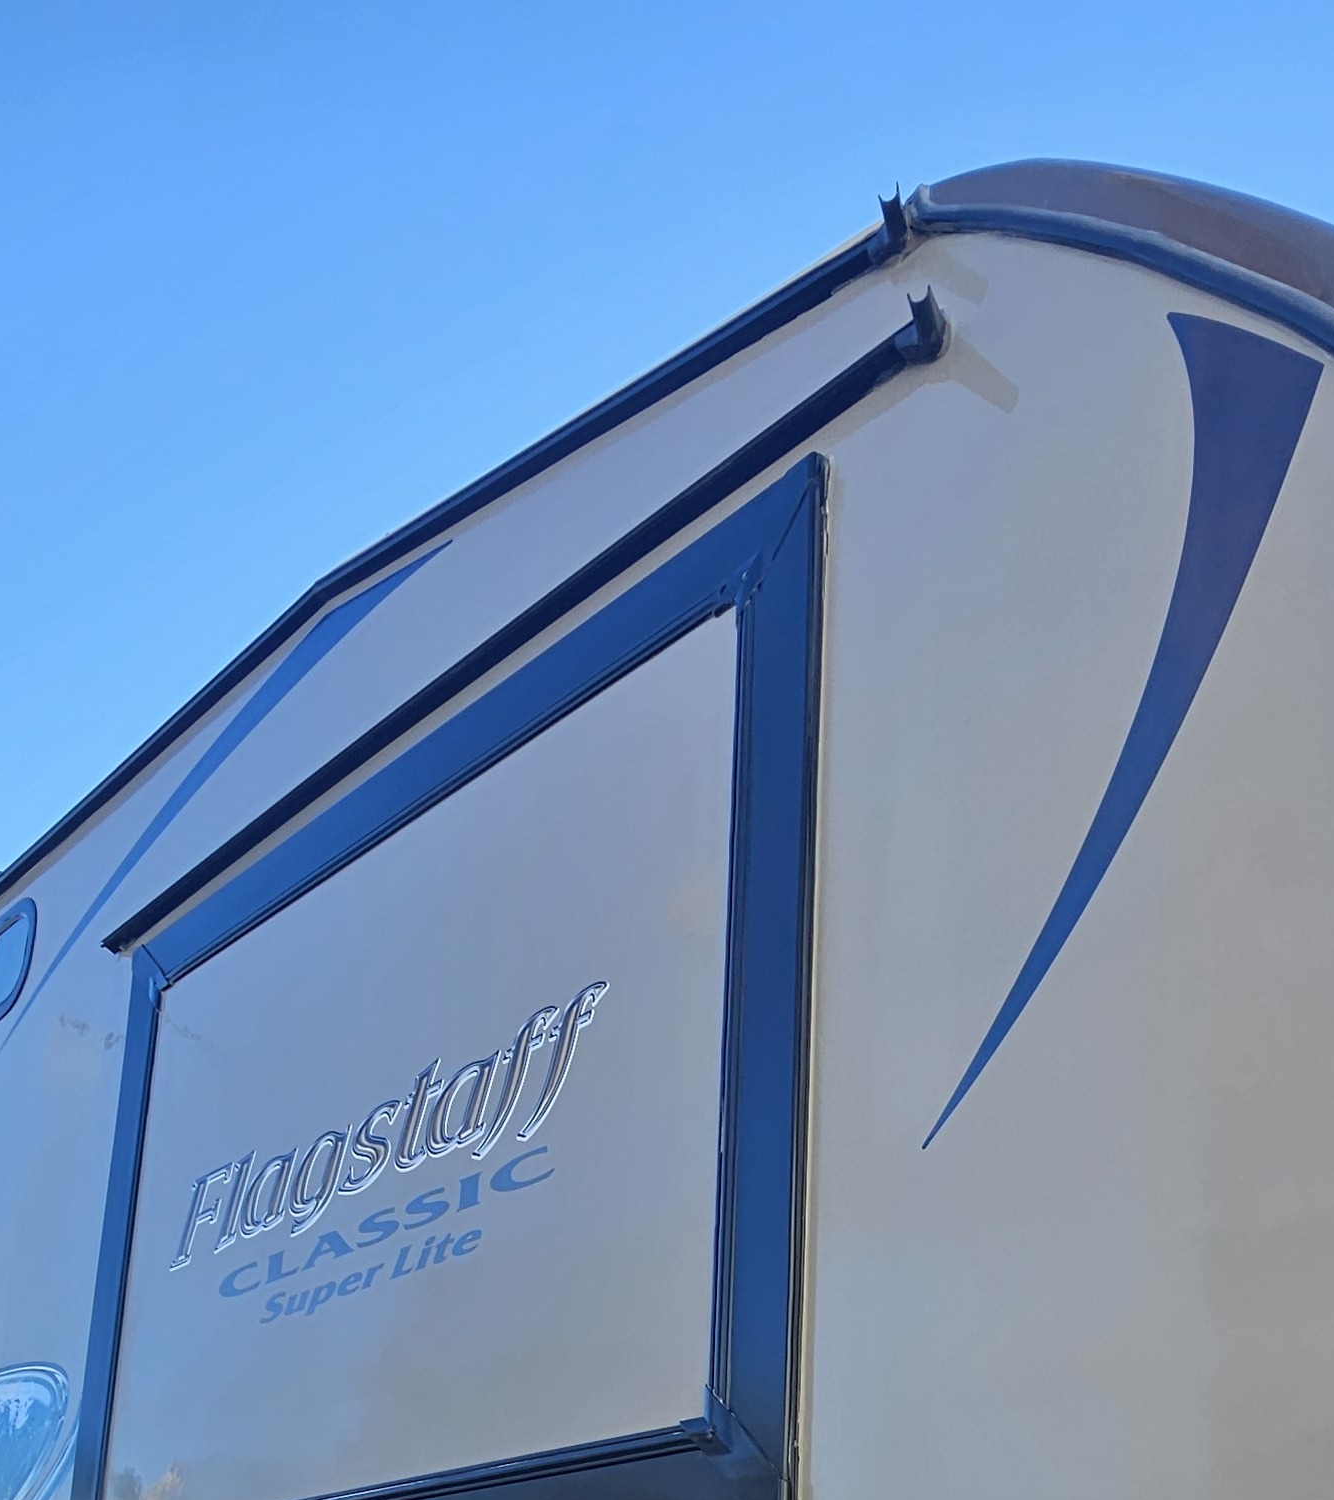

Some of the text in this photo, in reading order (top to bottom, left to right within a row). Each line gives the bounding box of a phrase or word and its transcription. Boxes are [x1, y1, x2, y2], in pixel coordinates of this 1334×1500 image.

[169, 980, 610, 1272] Flagstaff
[219, 1145, 555, 1297] CLASSIC
[259, 1229, 482, 1324] Super Lite
